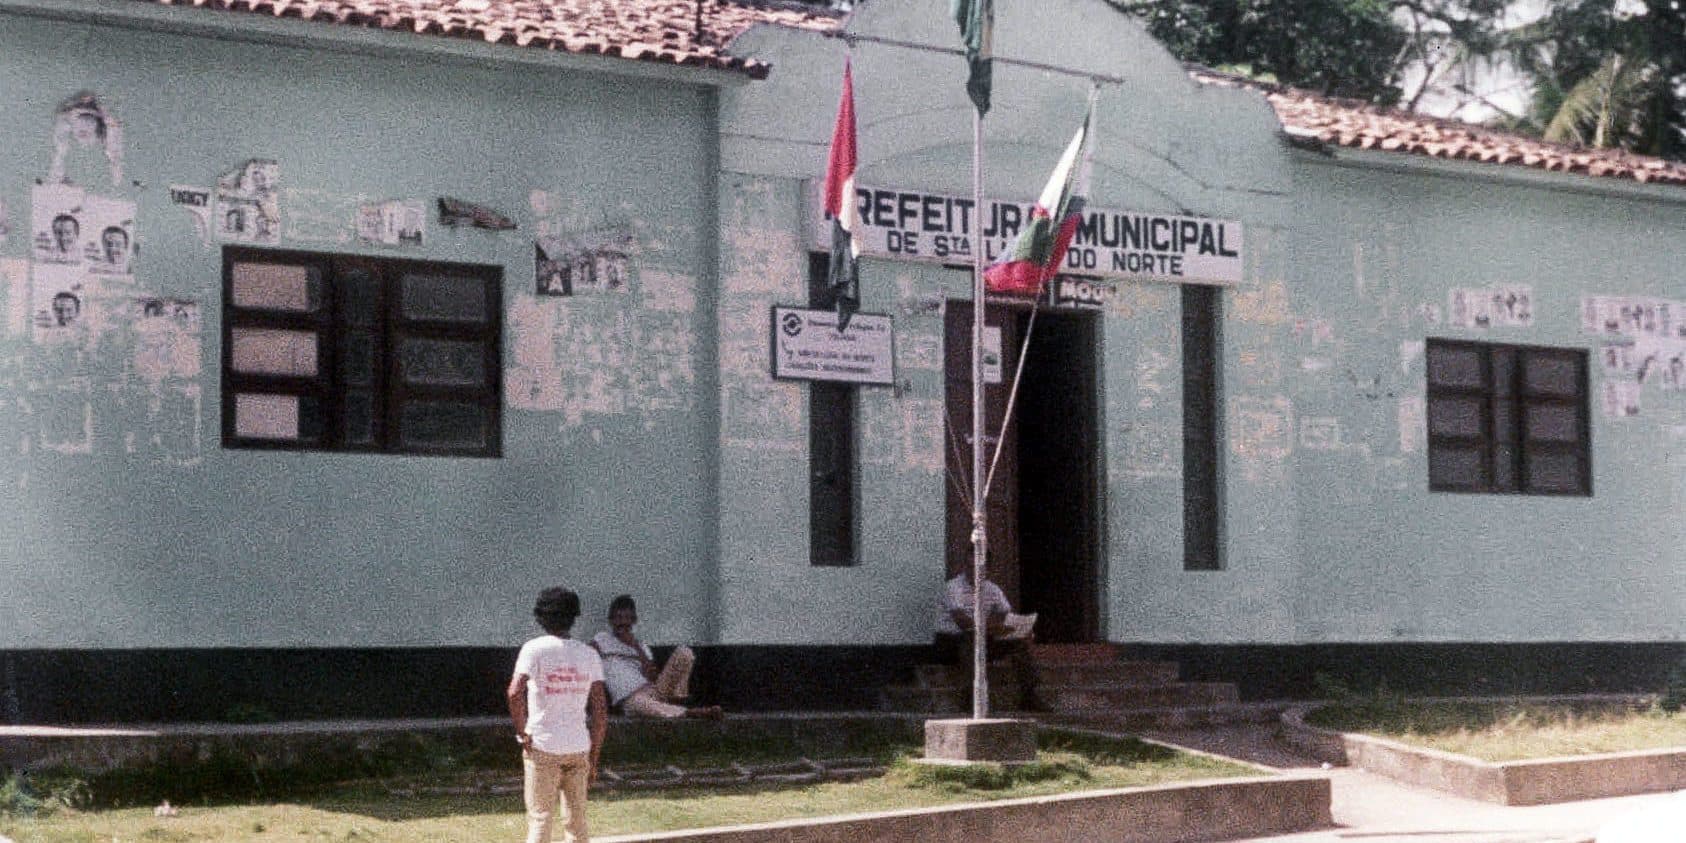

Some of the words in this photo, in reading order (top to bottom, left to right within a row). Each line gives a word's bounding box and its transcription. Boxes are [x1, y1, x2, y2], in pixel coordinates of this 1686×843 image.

[825, 188, 1036, 239] REFEITUR
[1075, 211, 1237, 257] MUNICIPAL
[887, 230, 919, 253] DE
[1067, 247, 1097, 268] DO
[1112, 252, 1183, 276] NORTE
